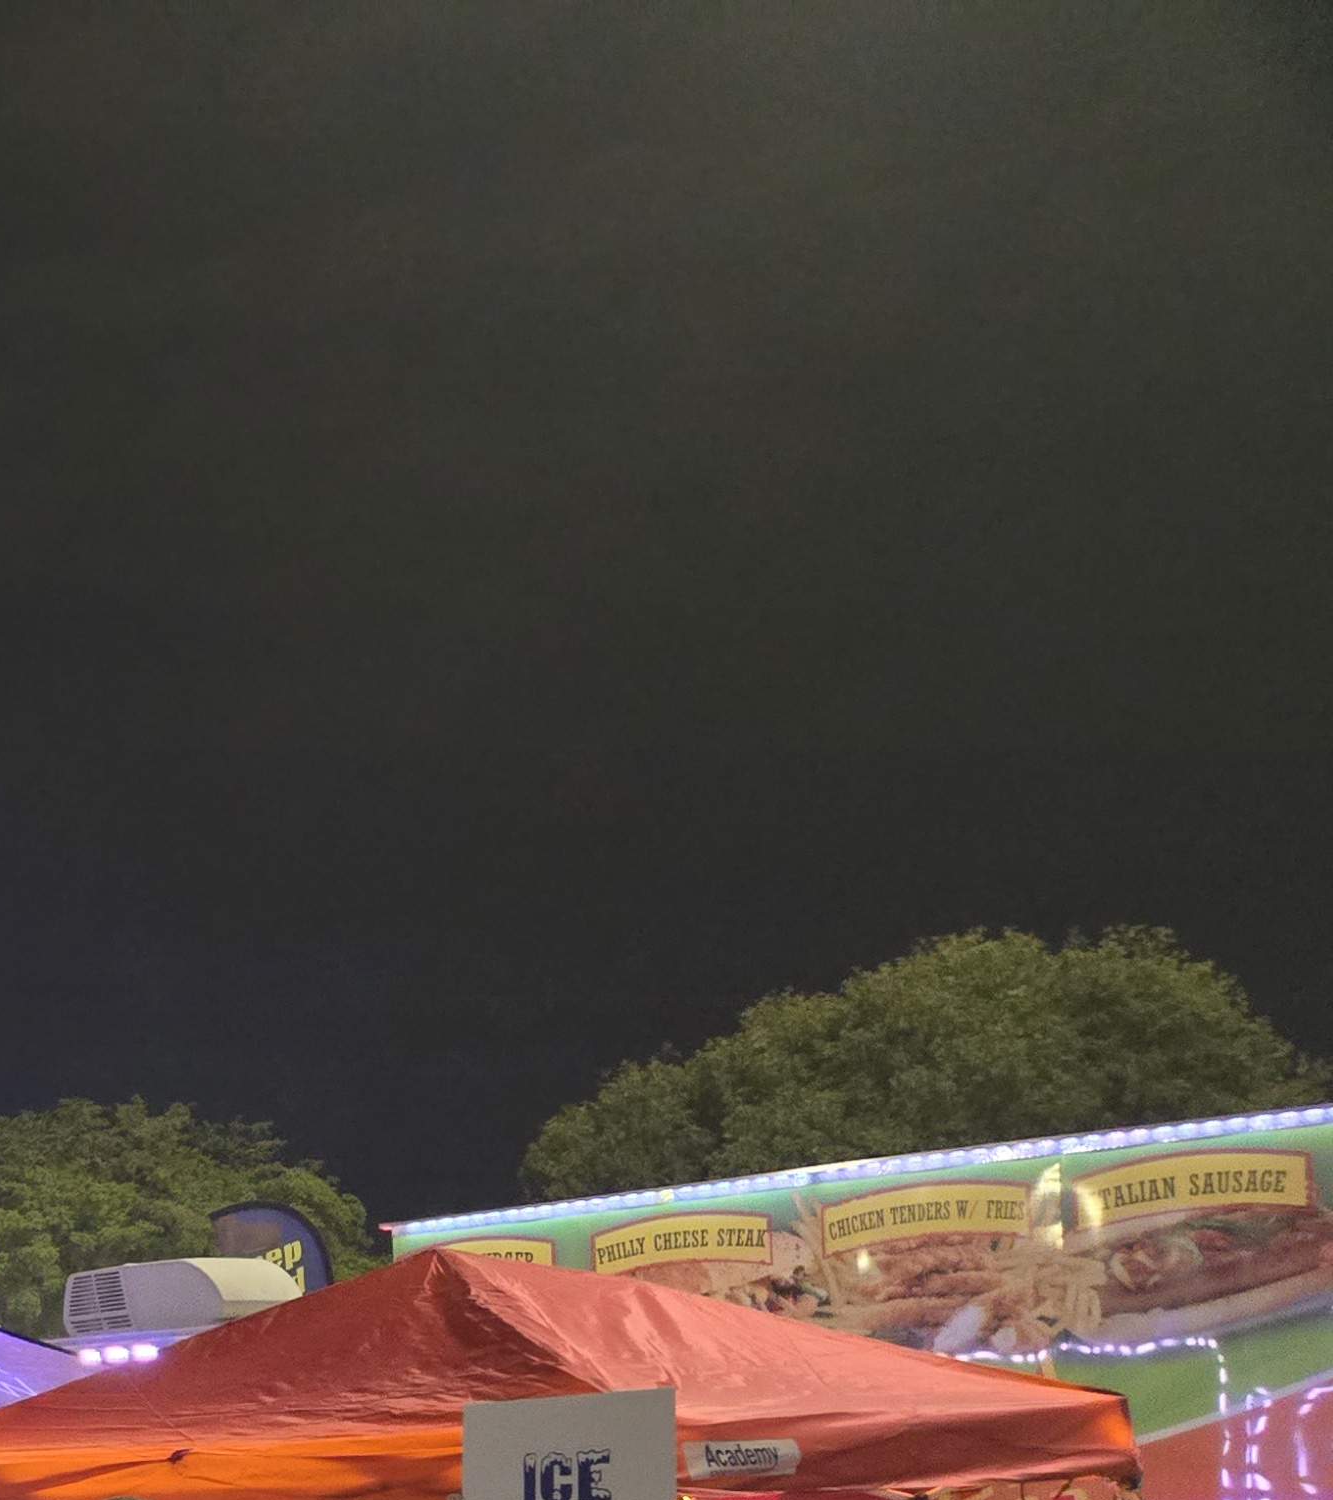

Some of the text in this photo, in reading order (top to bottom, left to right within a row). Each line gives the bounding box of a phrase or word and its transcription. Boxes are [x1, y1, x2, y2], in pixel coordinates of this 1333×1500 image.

[1096, 1169, 1287, 1210] TALIAN SAUSAGE
[827, 1207, 886, 1241] CHICKEN
[889, 1200, 951, 1226] TENDERS
[986, 1199, 1026, 1221] FRIES
[596, 1228, 768, 1265] PHILLY CHEESE STEAK
[704, 1443, 780, 1470] Academy
